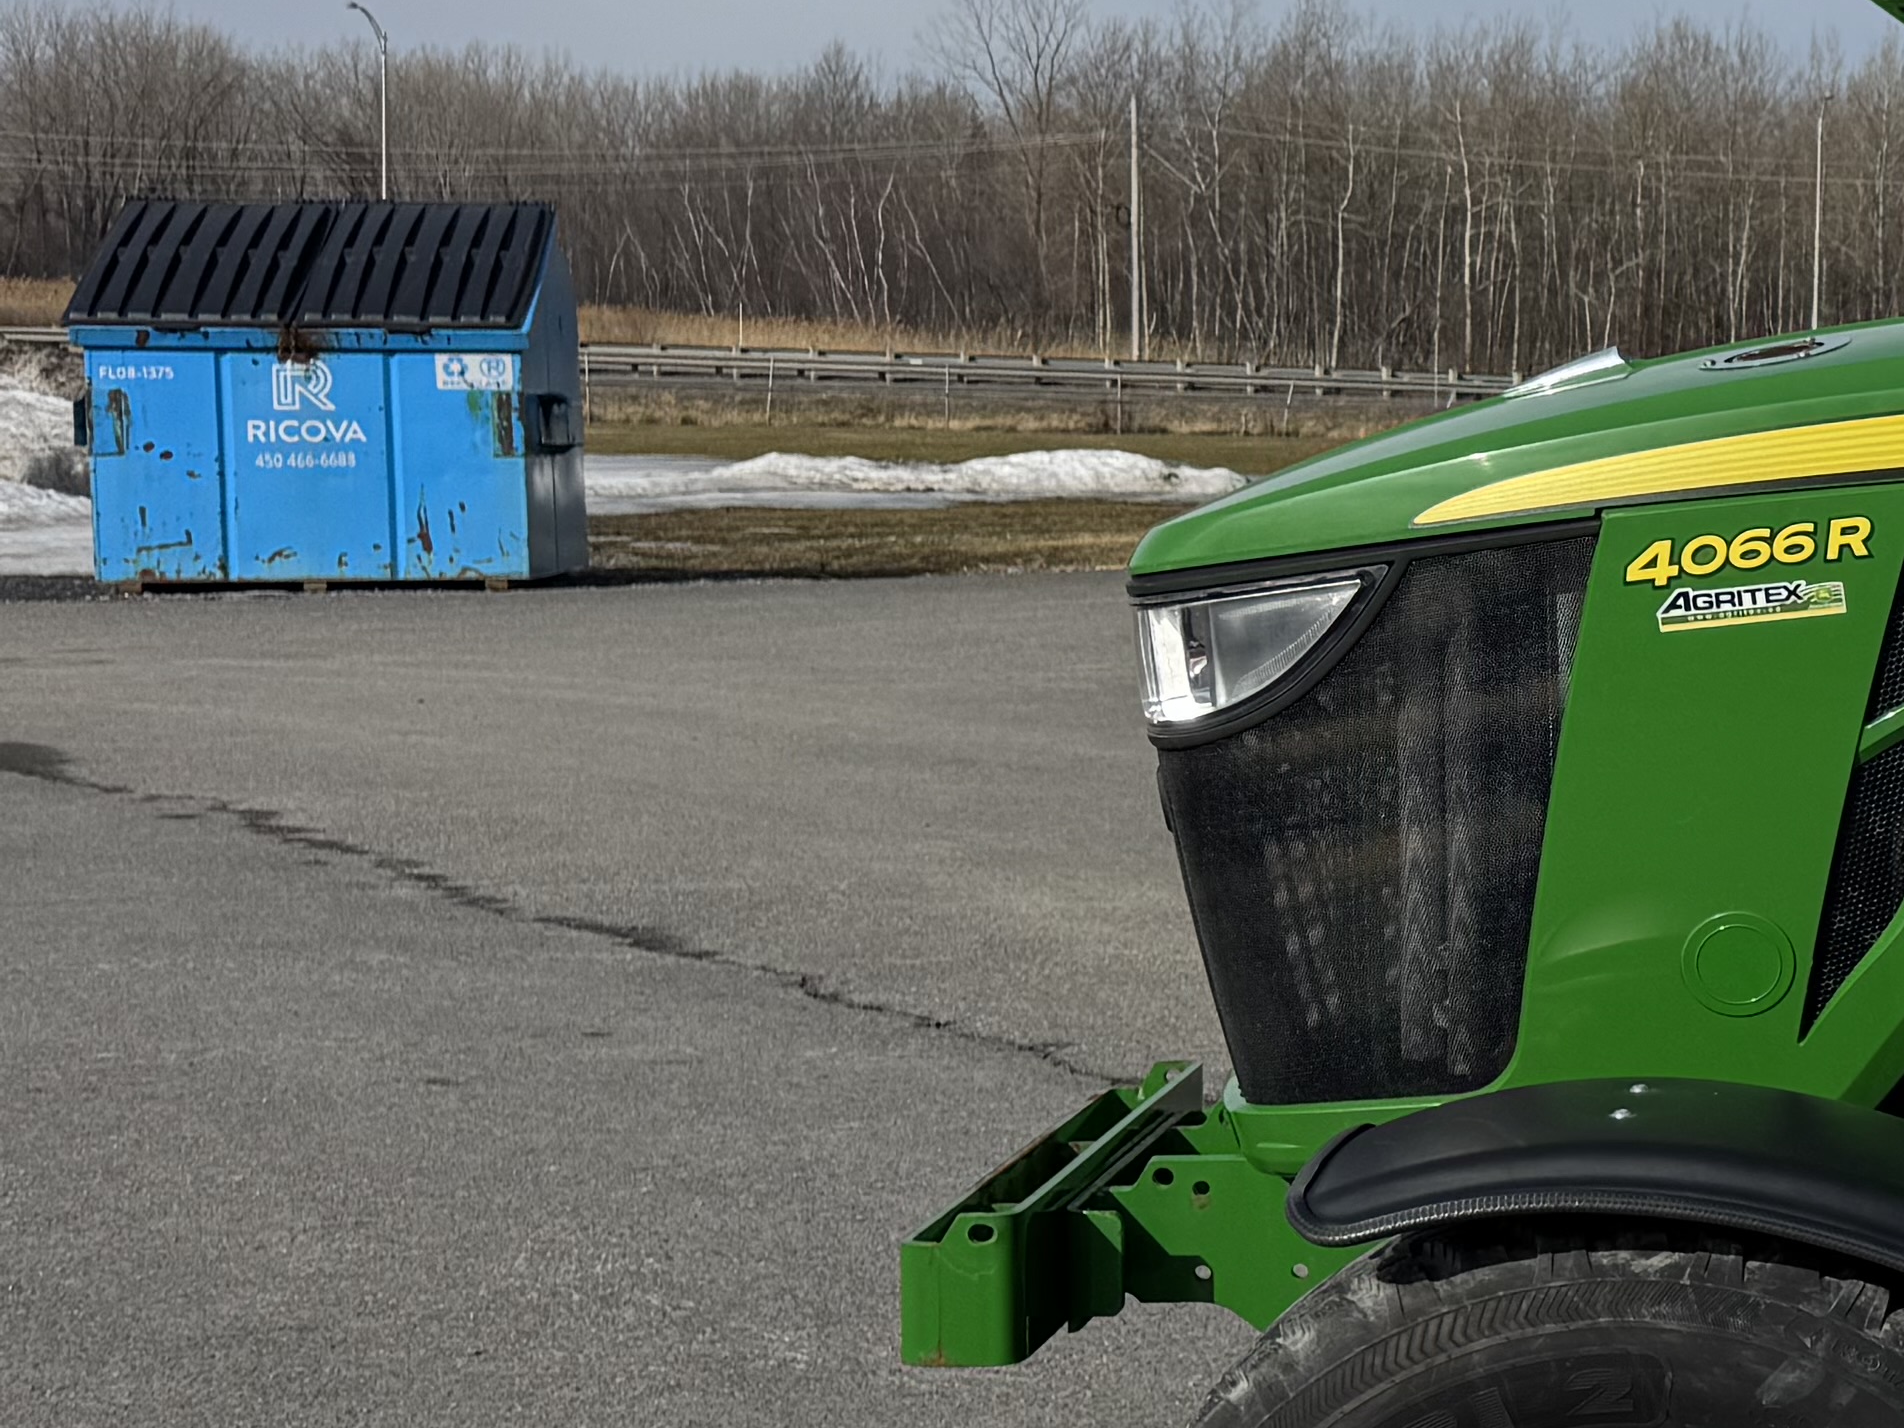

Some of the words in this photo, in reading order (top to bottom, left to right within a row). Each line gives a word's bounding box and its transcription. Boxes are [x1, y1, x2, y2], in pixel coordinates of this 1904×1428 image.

[246, 419, 368, 444] RICOVA
[1661, 583, 1804, 614] AGRITEX
[1562, 1368, 1638, 1416] 2
